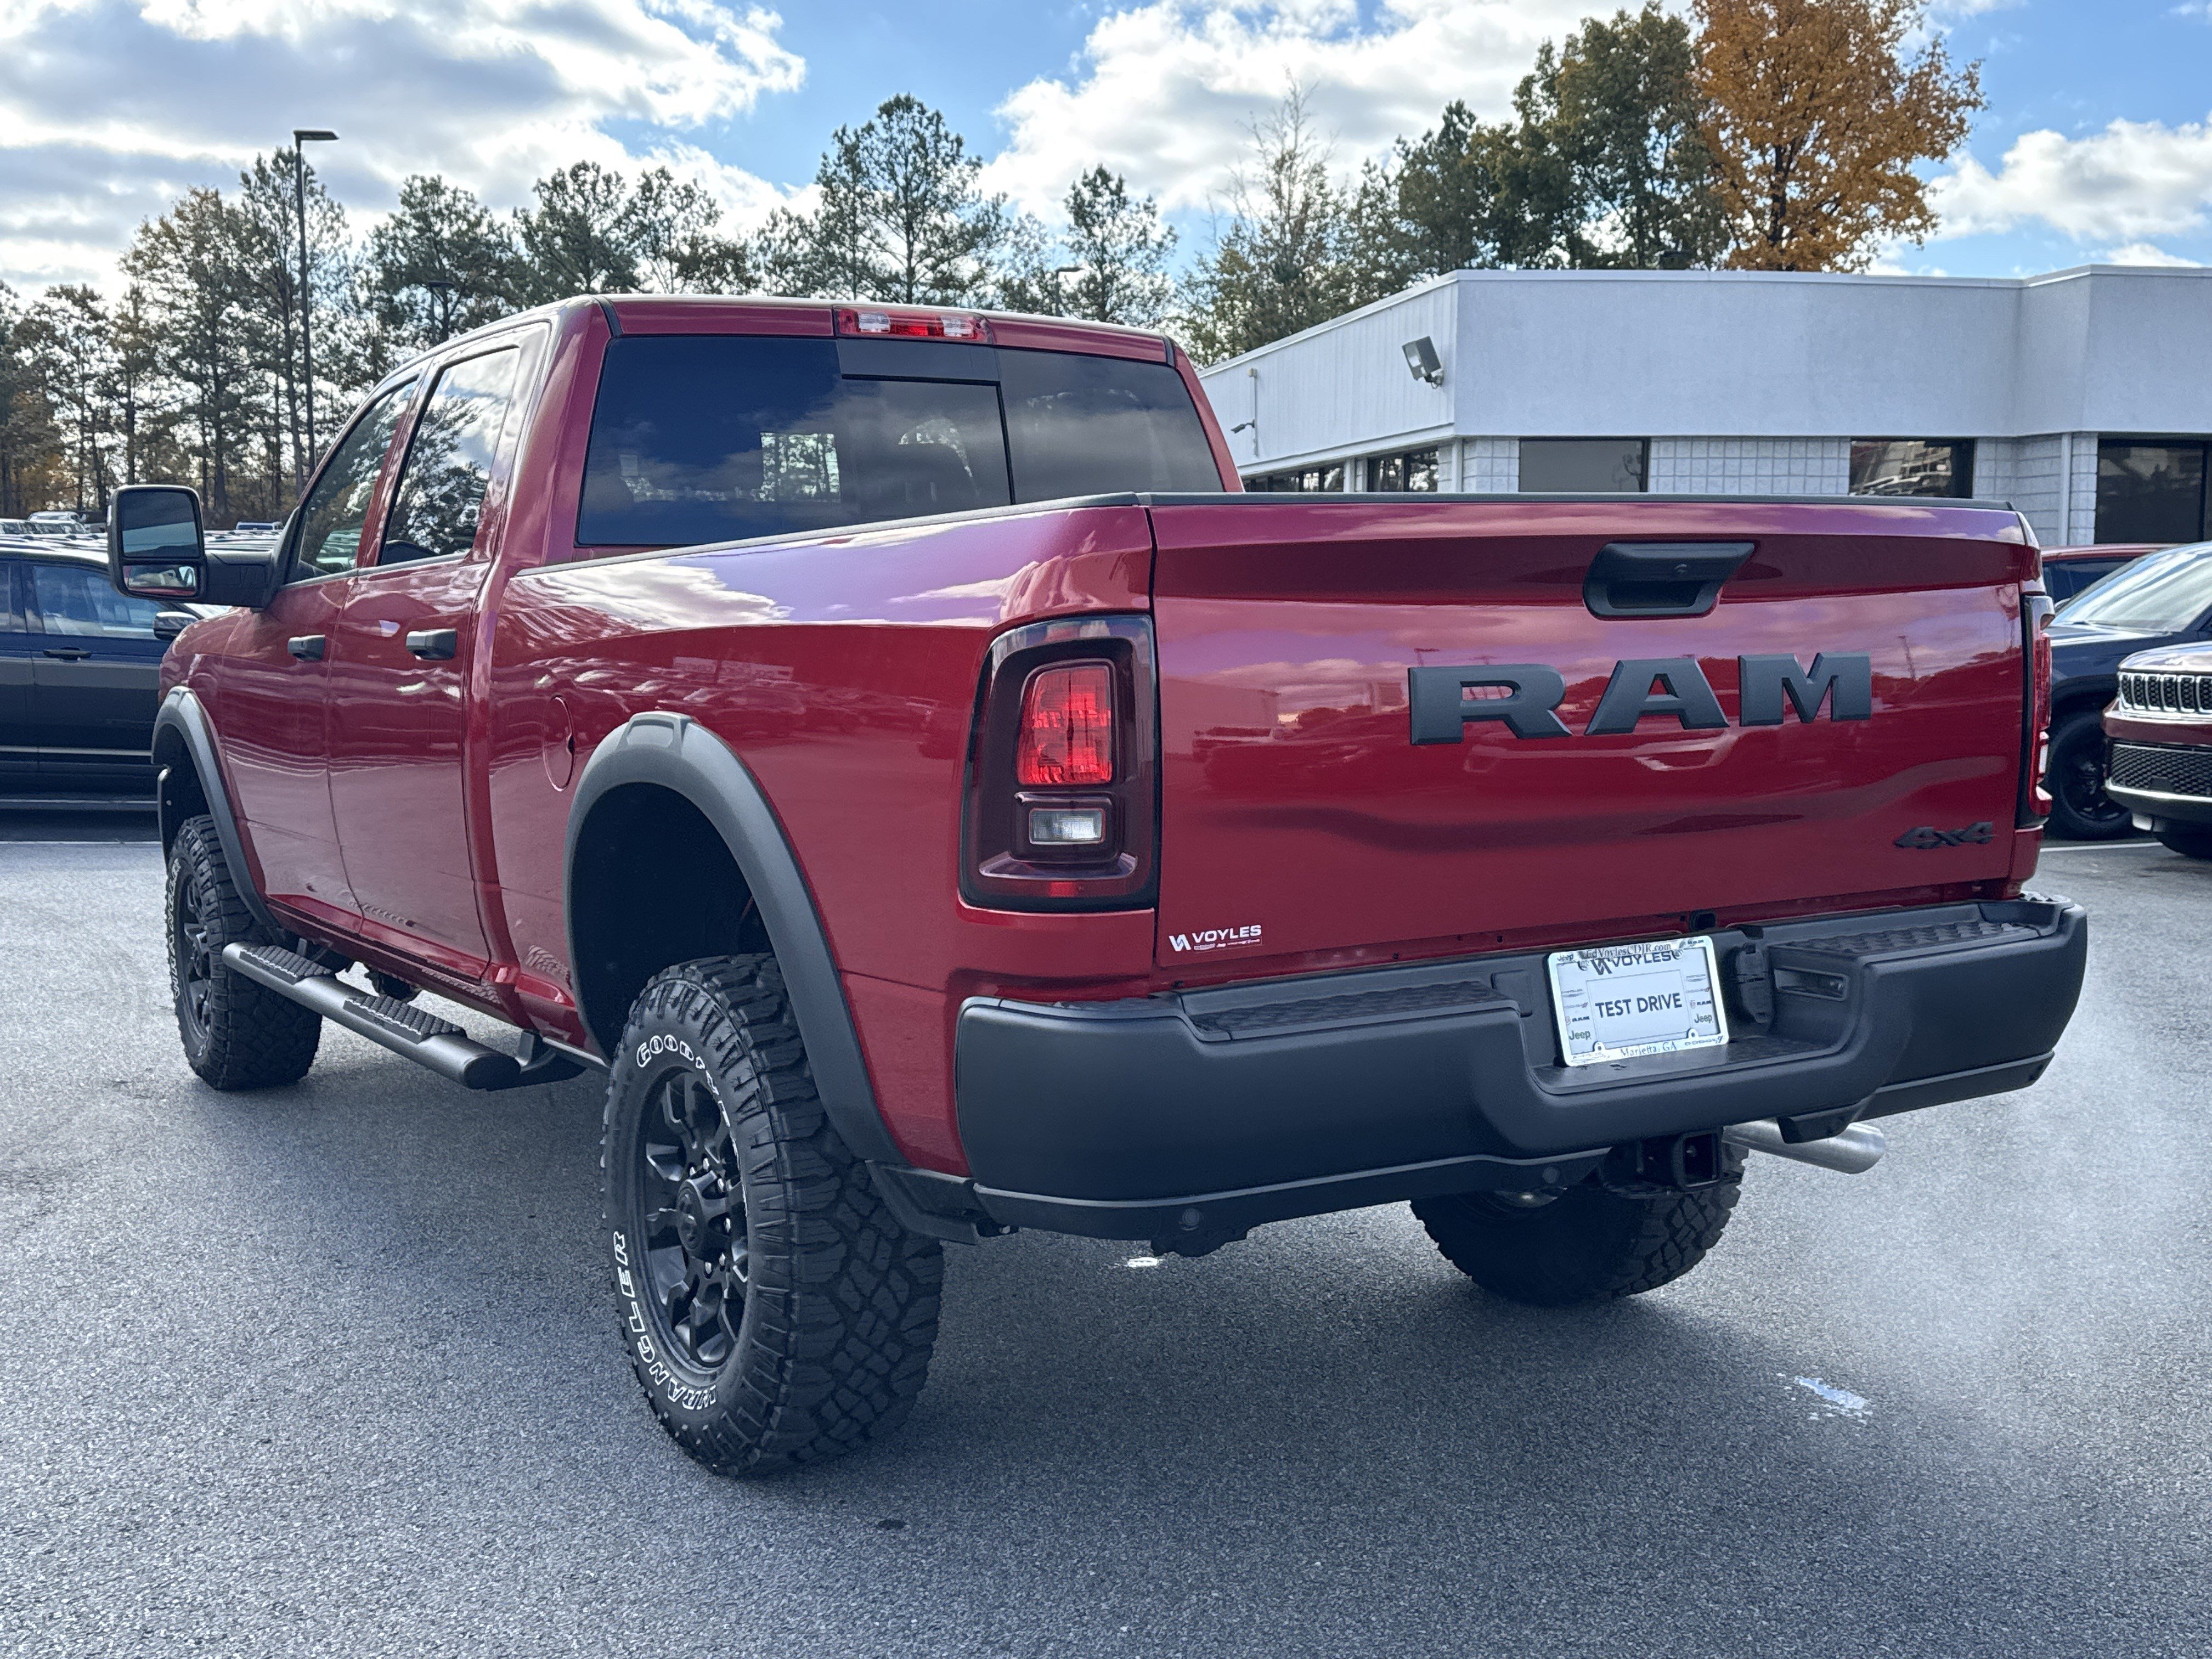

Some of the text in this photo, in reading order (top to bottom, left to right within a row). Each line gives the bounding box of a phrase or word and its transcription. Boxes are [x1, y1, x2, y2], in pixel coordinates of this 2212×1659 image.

[1408, 652, 1871, 745] RAM
[1192, 924, 1262, 943] VOYLES
[1613, 950, 1672, 967] VOYLES
[1594, 992, 1683, 1018] TEST DRIVE
[1694, 1013, 1713, 1024] Jeep
[1569, 1030, 1590, 1041] Jeep
[1662, 1041, 1678, 1052] GA
[613, 1231, 716, 1410] WRANGLER
